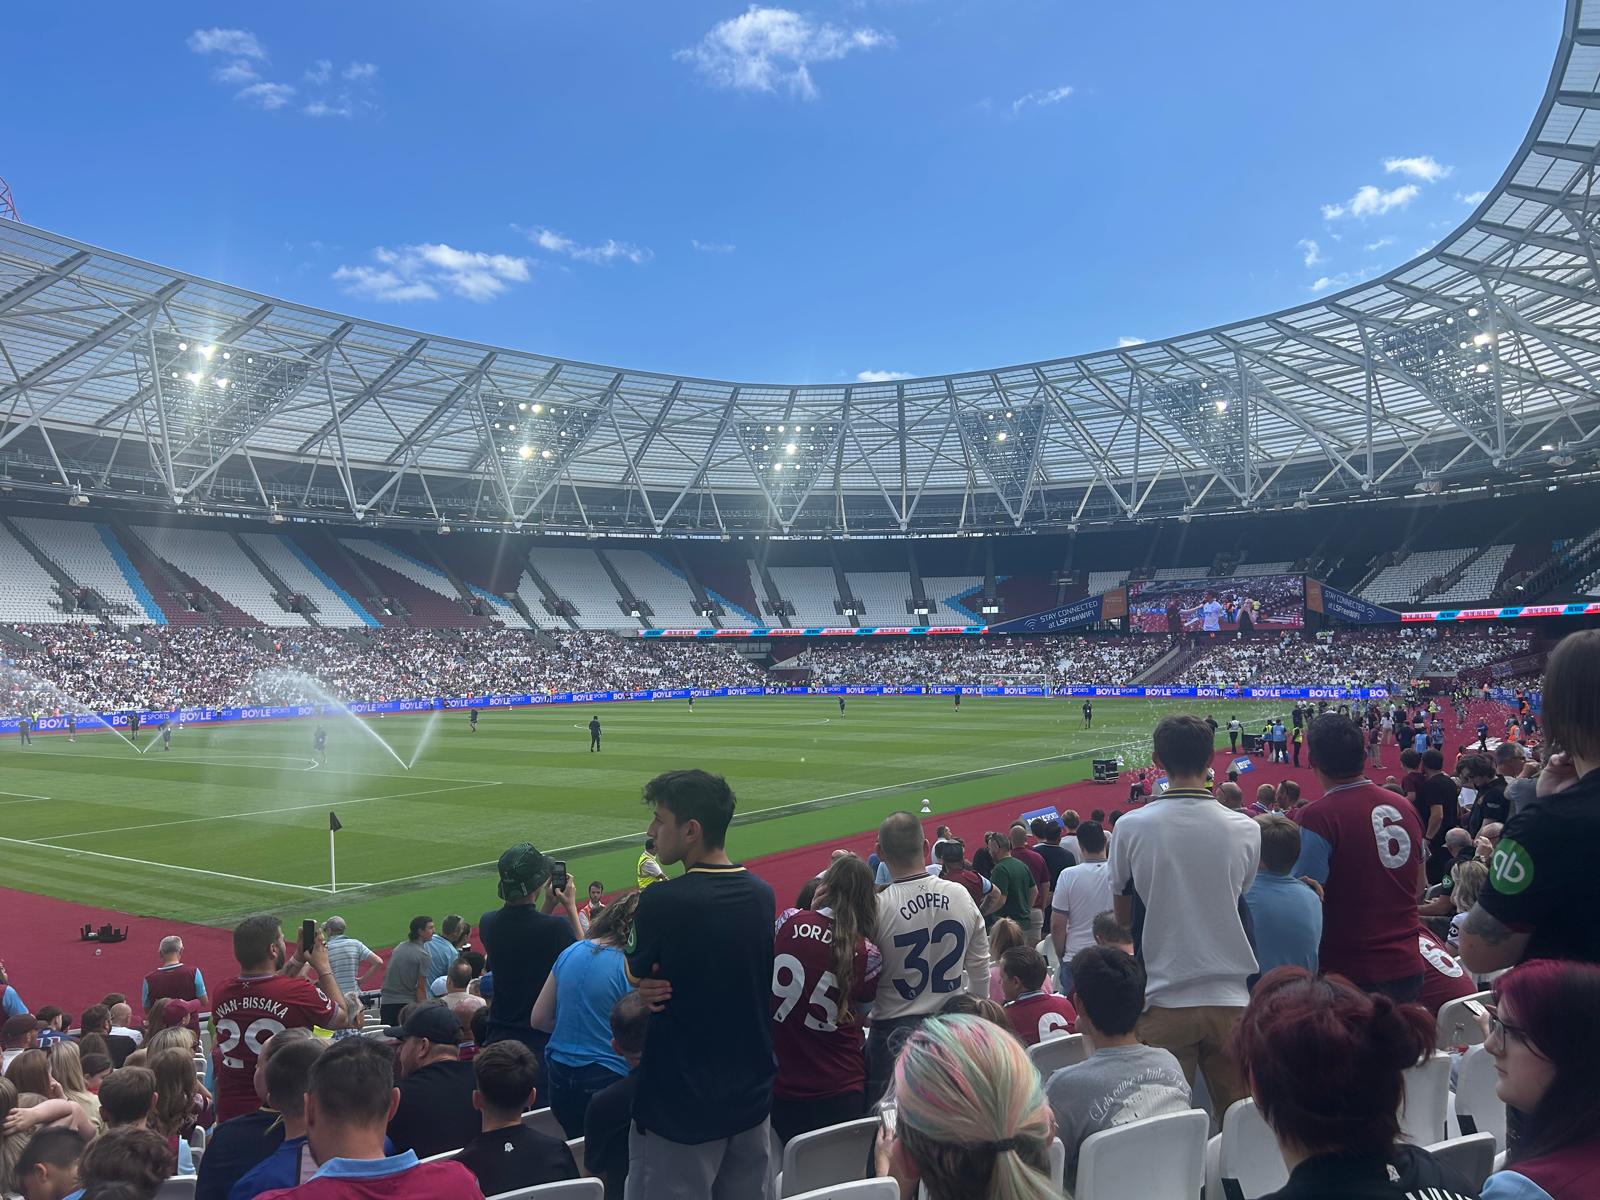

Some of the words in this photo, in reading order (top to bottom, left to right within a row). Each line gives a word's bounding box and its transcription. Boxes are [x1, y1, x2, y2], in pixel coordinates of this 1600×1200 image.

[1040, 612, 1057, 623] STAY
[1057, 600, 1098, 617] CONNECTED
[1048, 621, 1056, 629] at
[1004, 687, 1027, 695] BOYLE
[1145, 688, 1171, 696] BOYLE
[1251, 689, 1280, 697] BOYLE
[1309, 689, 1339, 697] BOYLE
[400, 702, 423, 710] BOYLE
[489, 698, 511, 706] BOYLE
[180, 712, 211, 721] BOYLE
[241, 709, 271, 719] BOYLE
[39, 719, 70, 729] BOYL
[112, 715, 147, 725] BOE
[1371, 804, 1411, 869] 6
[1493, 849, 1526, 883] qb
[900, 892, 950, 921] COOPER
[891, 919, 966, 1001] 32
[1419, 936, 1463, 978] 6
[771, 953, 839, 1033] 95
[216, 996, 289, 1019] WAN-BISSAKA
[216, 1017, 288, 1069] 29
